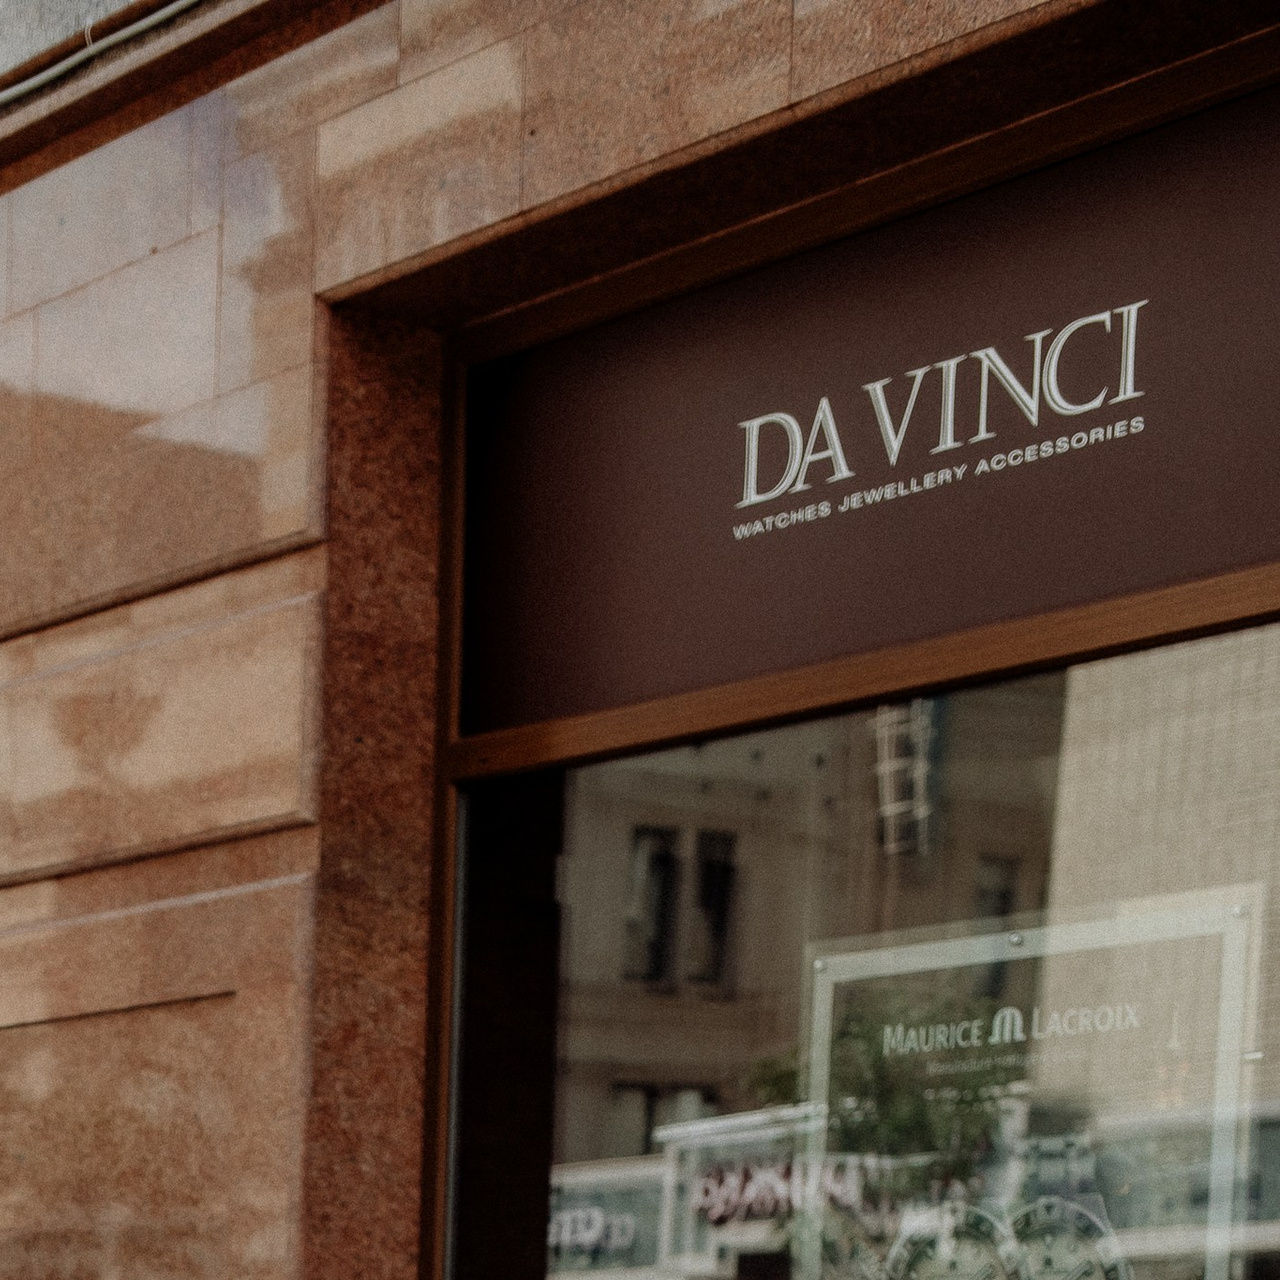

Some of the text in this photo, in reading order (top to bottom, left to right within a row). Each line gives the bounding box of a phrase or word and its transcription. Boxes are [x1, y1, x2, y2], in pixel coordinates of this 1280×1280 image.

[733, 299, 1150, 510] DA VINCI
[732, 415, 1146, 541] WATCHES JEWELLERY ACCESSORIES
[881, 1018, 984, 1056] MAURICE
[1029, 1001, 1142, 1039] LACROIX
